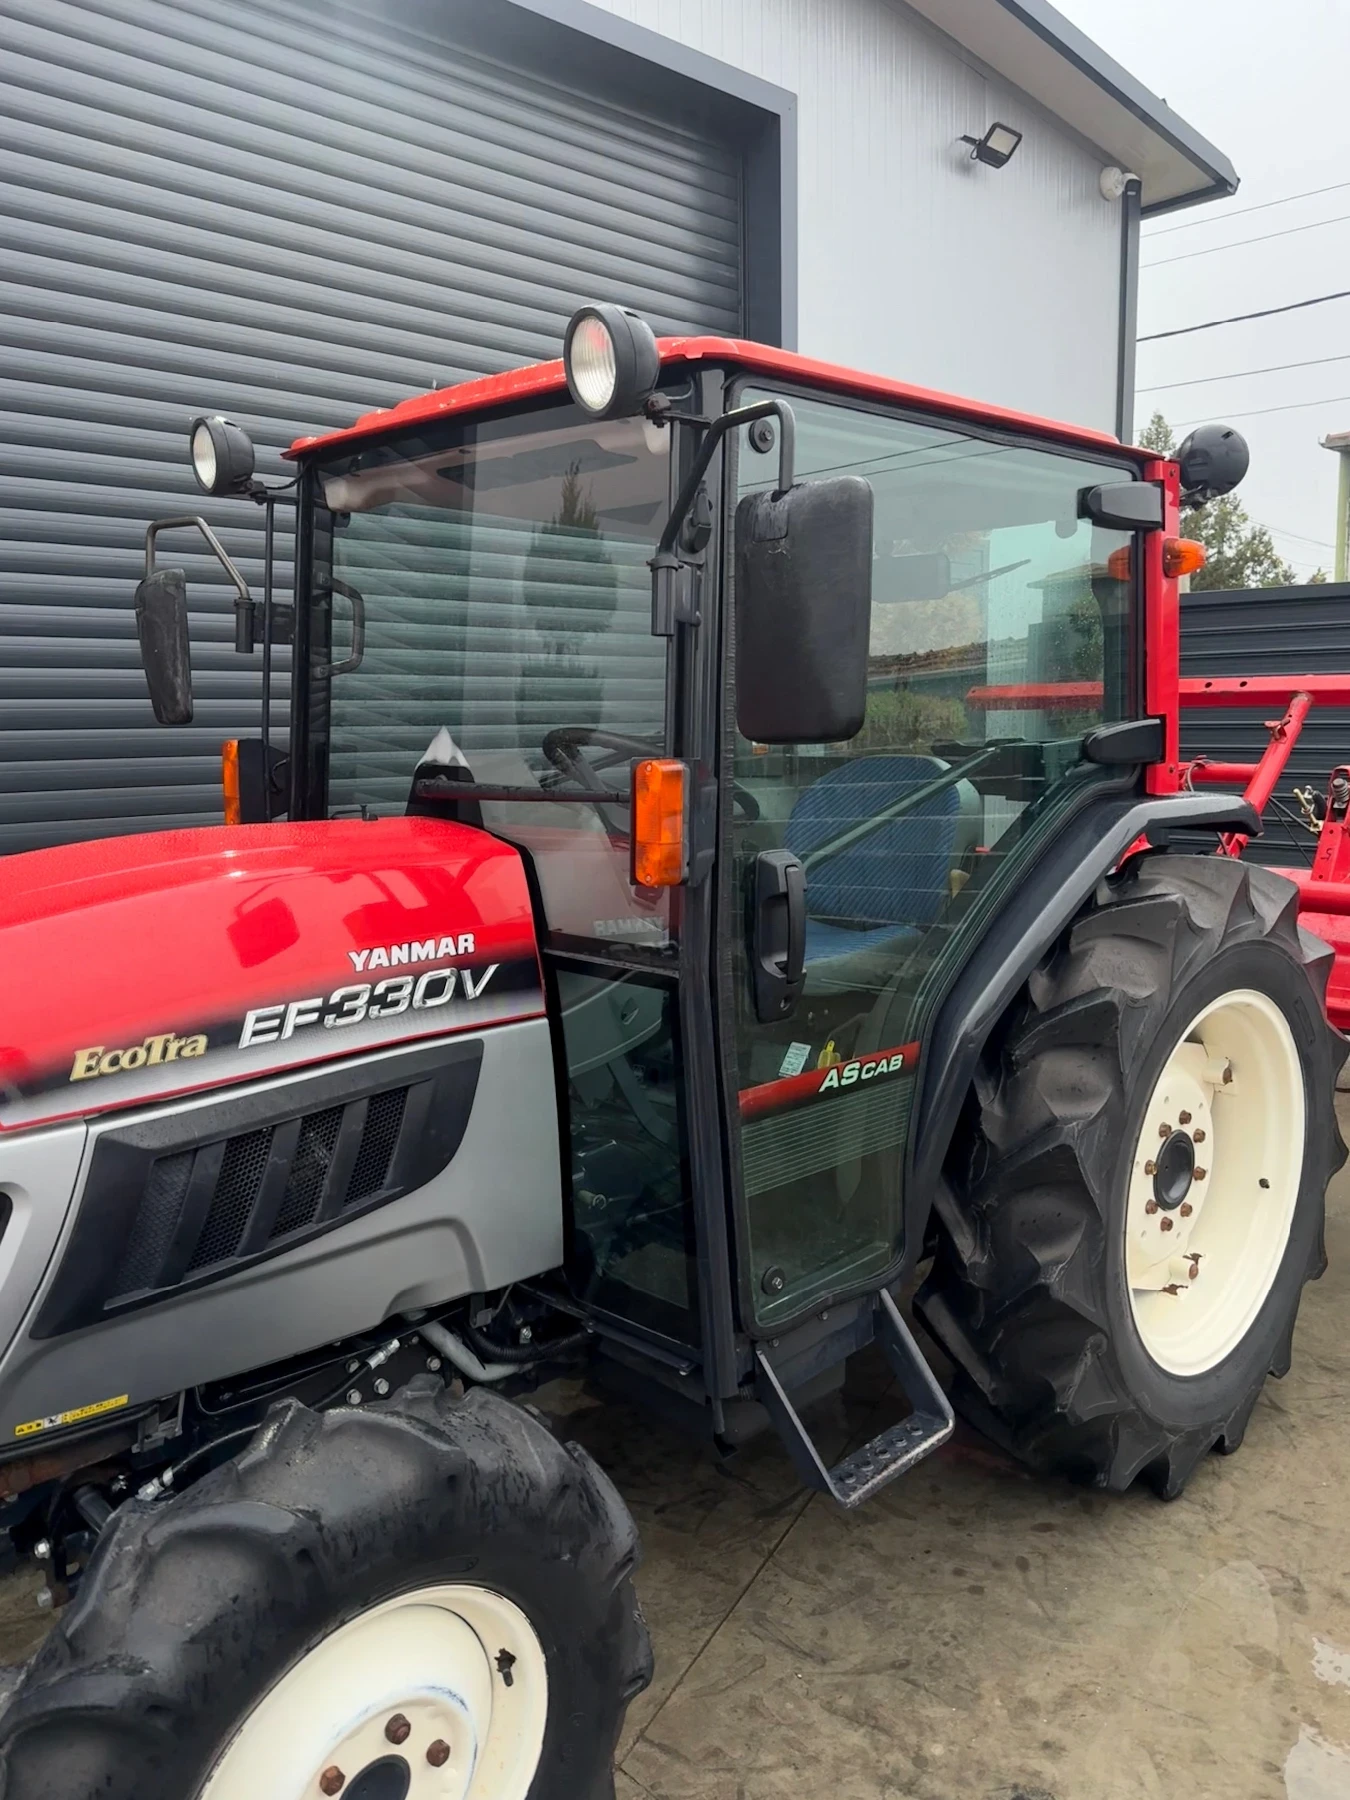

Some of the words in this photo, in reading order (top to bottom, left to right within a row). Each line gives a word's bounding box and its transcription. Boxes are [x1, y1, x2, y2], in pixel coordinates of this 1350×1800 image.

[348, 933, 476, 973] YANMAR
[238, 963, 500, 1050] EF330V
[69, 1032, 208, 1082] EcoTra
